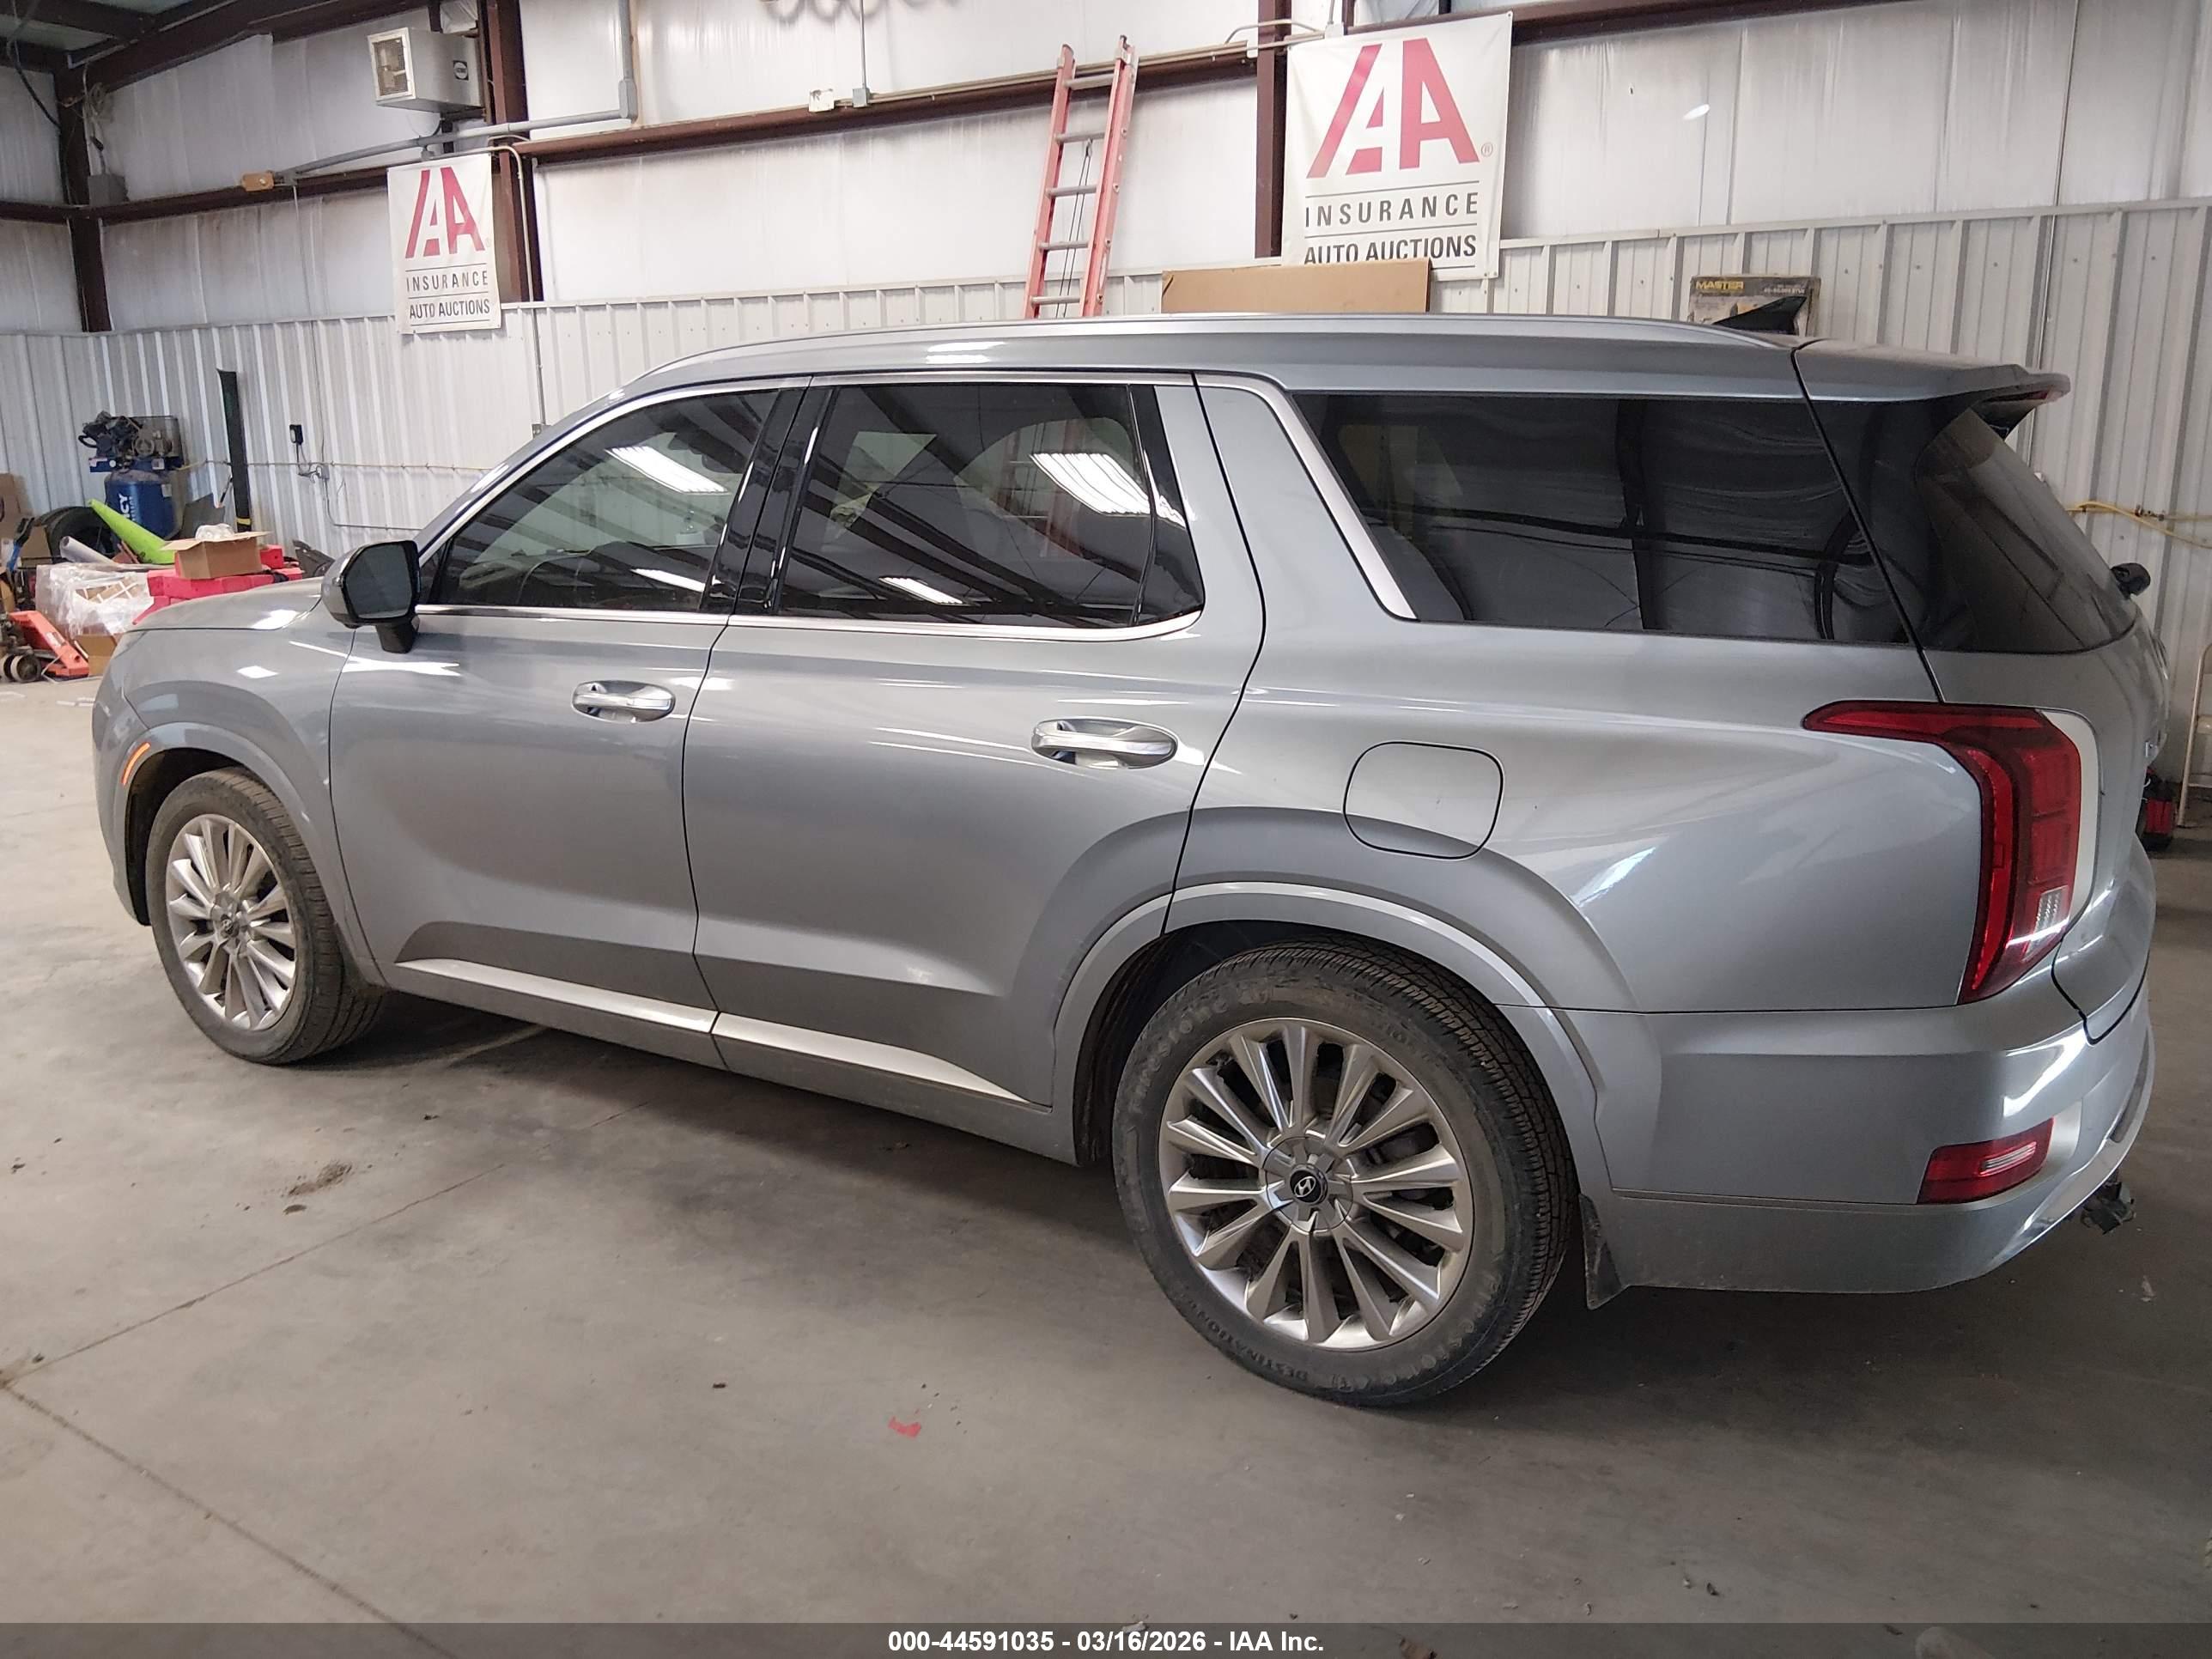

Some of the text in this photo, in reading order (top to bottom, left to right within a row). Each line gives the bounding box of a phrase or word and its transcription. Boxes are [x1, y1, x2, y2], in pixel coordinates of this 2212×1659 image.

[1305, 191, 1479, 228] INSURANCE
[1304, 234, 1477, 265] AUTO AUCTIONS
[406, 270, 489, 292] INSURANCE
[1696, 281, 1745, 290] MASTER
[410, 299, 490, 319] AUTO AUCTIONS
